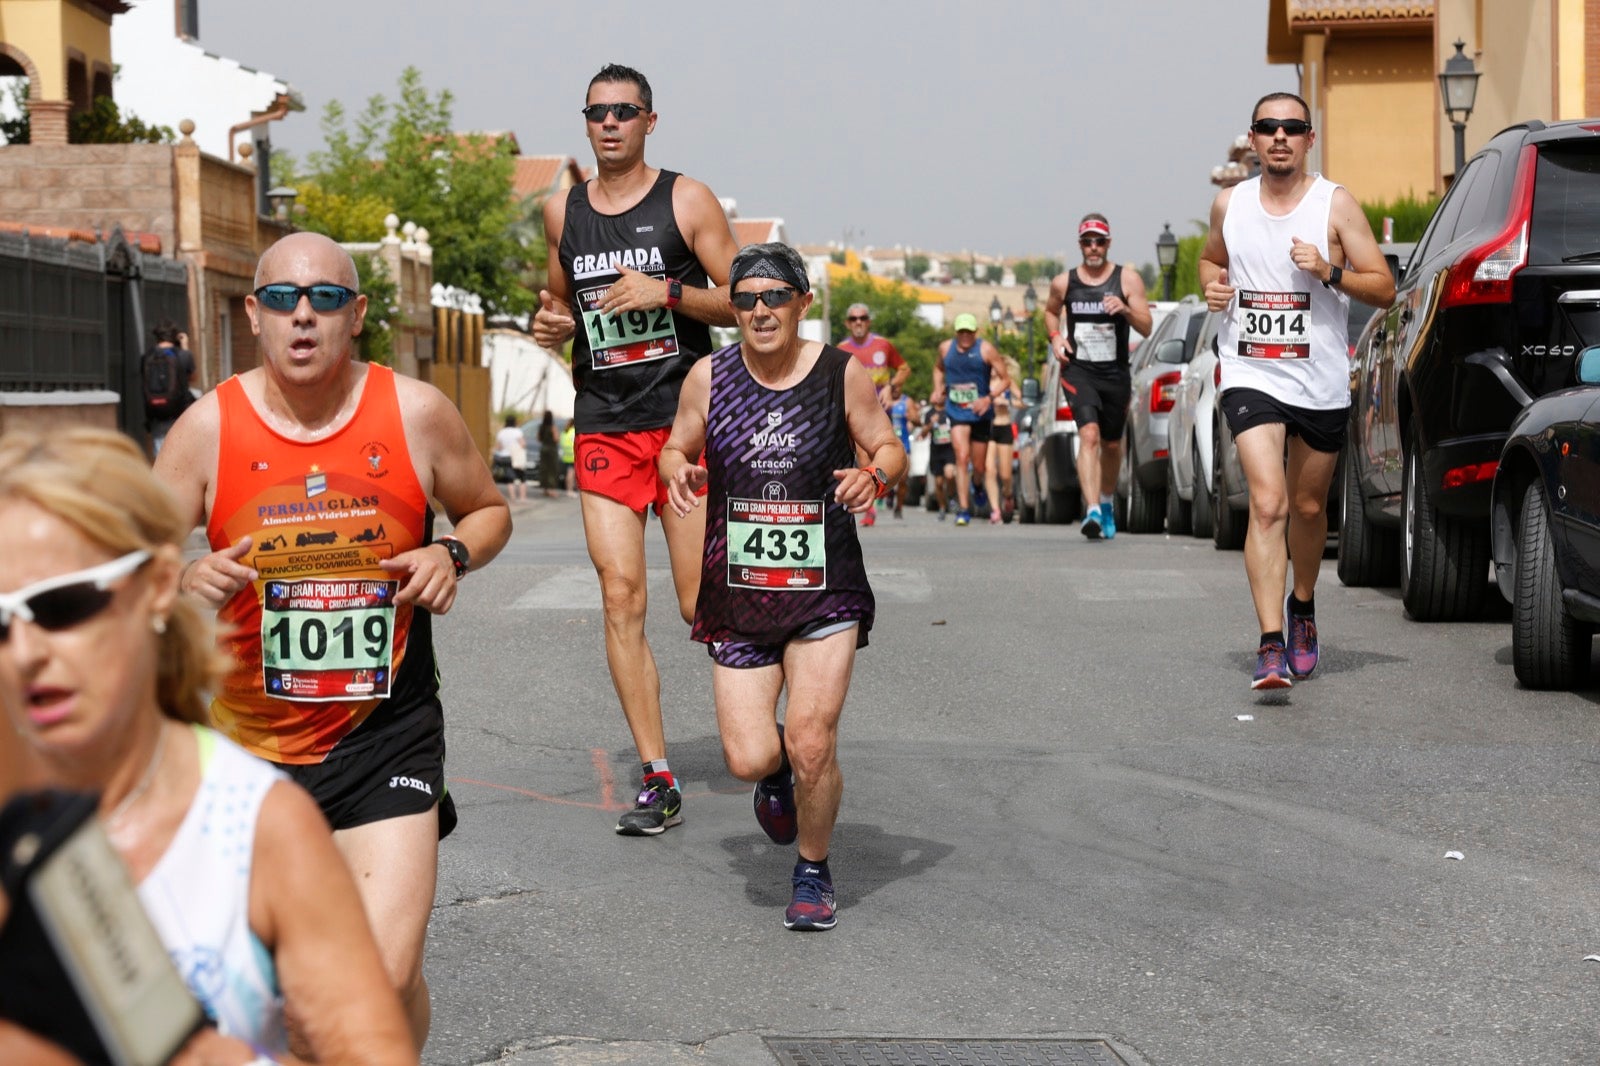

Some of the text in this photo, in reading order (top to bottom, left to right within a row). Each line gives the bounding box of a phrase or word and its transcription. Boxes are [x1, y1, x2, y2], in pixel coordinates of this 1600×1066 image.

[573, 247, 663, 274] GRANADA
[597, 288, 610, 300] GRA
[1264, 293, 1282, 302] PREMIO
[1283, 294, 1290, 302] DE
[1291, 294, 1306, 302] FONDO
[1071, 302, 1104, 311] GRANA
[591, 309, 671, 342] 1192
[1246, 312, 1305, 335] 3014
[954, 391, 974, 399] 170
[753, 433, 796, 448] WAVE
[258, 496, 379, 517] PERSIALGLASS
[733, 501, 818, 514] XXXII GRAN PREMIO DE FONDO
[262, 508, 376, 526] Almacén de Vidrio Plano
[749, 514, 773, 522] DIPUTACIÓN
[777, 515, 804, 523] CRUZCAMPO
[743, 528, 810, 561] 433
[288, 550, 360, 564] EXCAVACIONES
[260, 562, 313, 575] FRANCISCO
[315, 558, 363, 571] DOMINGO,
[271, 584, 290, 598] XII
[291, 583, 314, 598] GRAN
[315, 583, 346, 597] PREMIO
[348, 583, 358, 596] DE
[289, 598, 324, 609] DIPUTACIÓN
[329, 597, 366, 609] CRUZCAMPO
[269, 614, 388, 661] 1019
